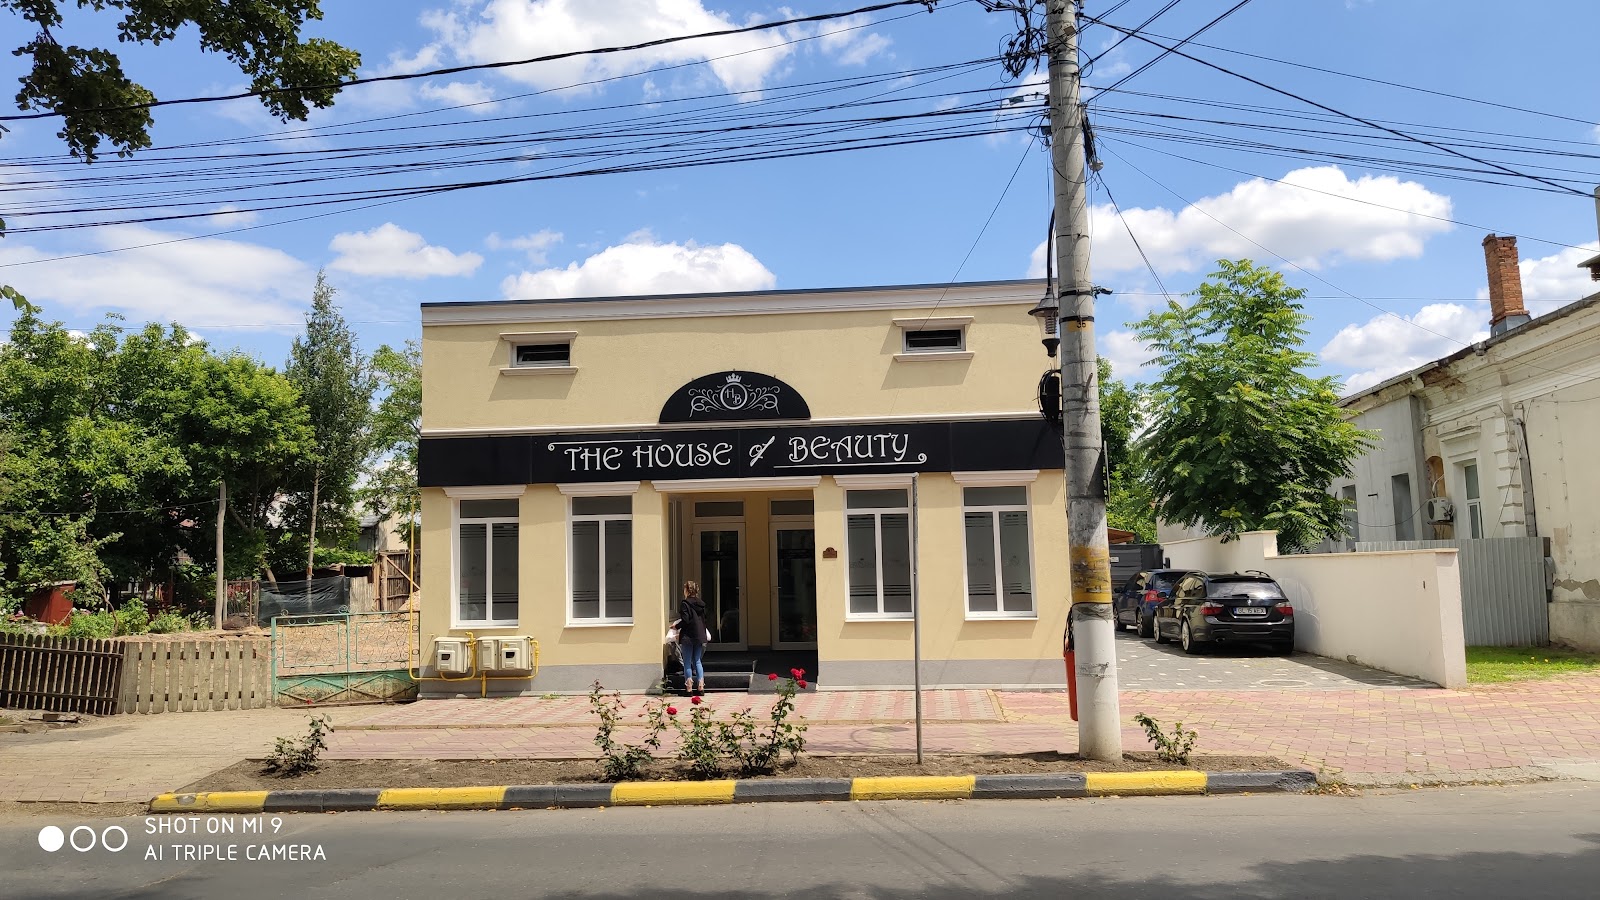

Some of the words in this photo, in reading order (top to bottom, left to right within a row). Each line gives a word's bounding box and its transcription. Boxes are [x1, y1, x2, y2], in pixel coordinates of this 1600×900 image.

[564, 446, 624, 471] THE
[632, 442, 733, 469] HOUSE
[748, 434, 777, 467] of
[788, 432, 909, 463] BEAUTY
